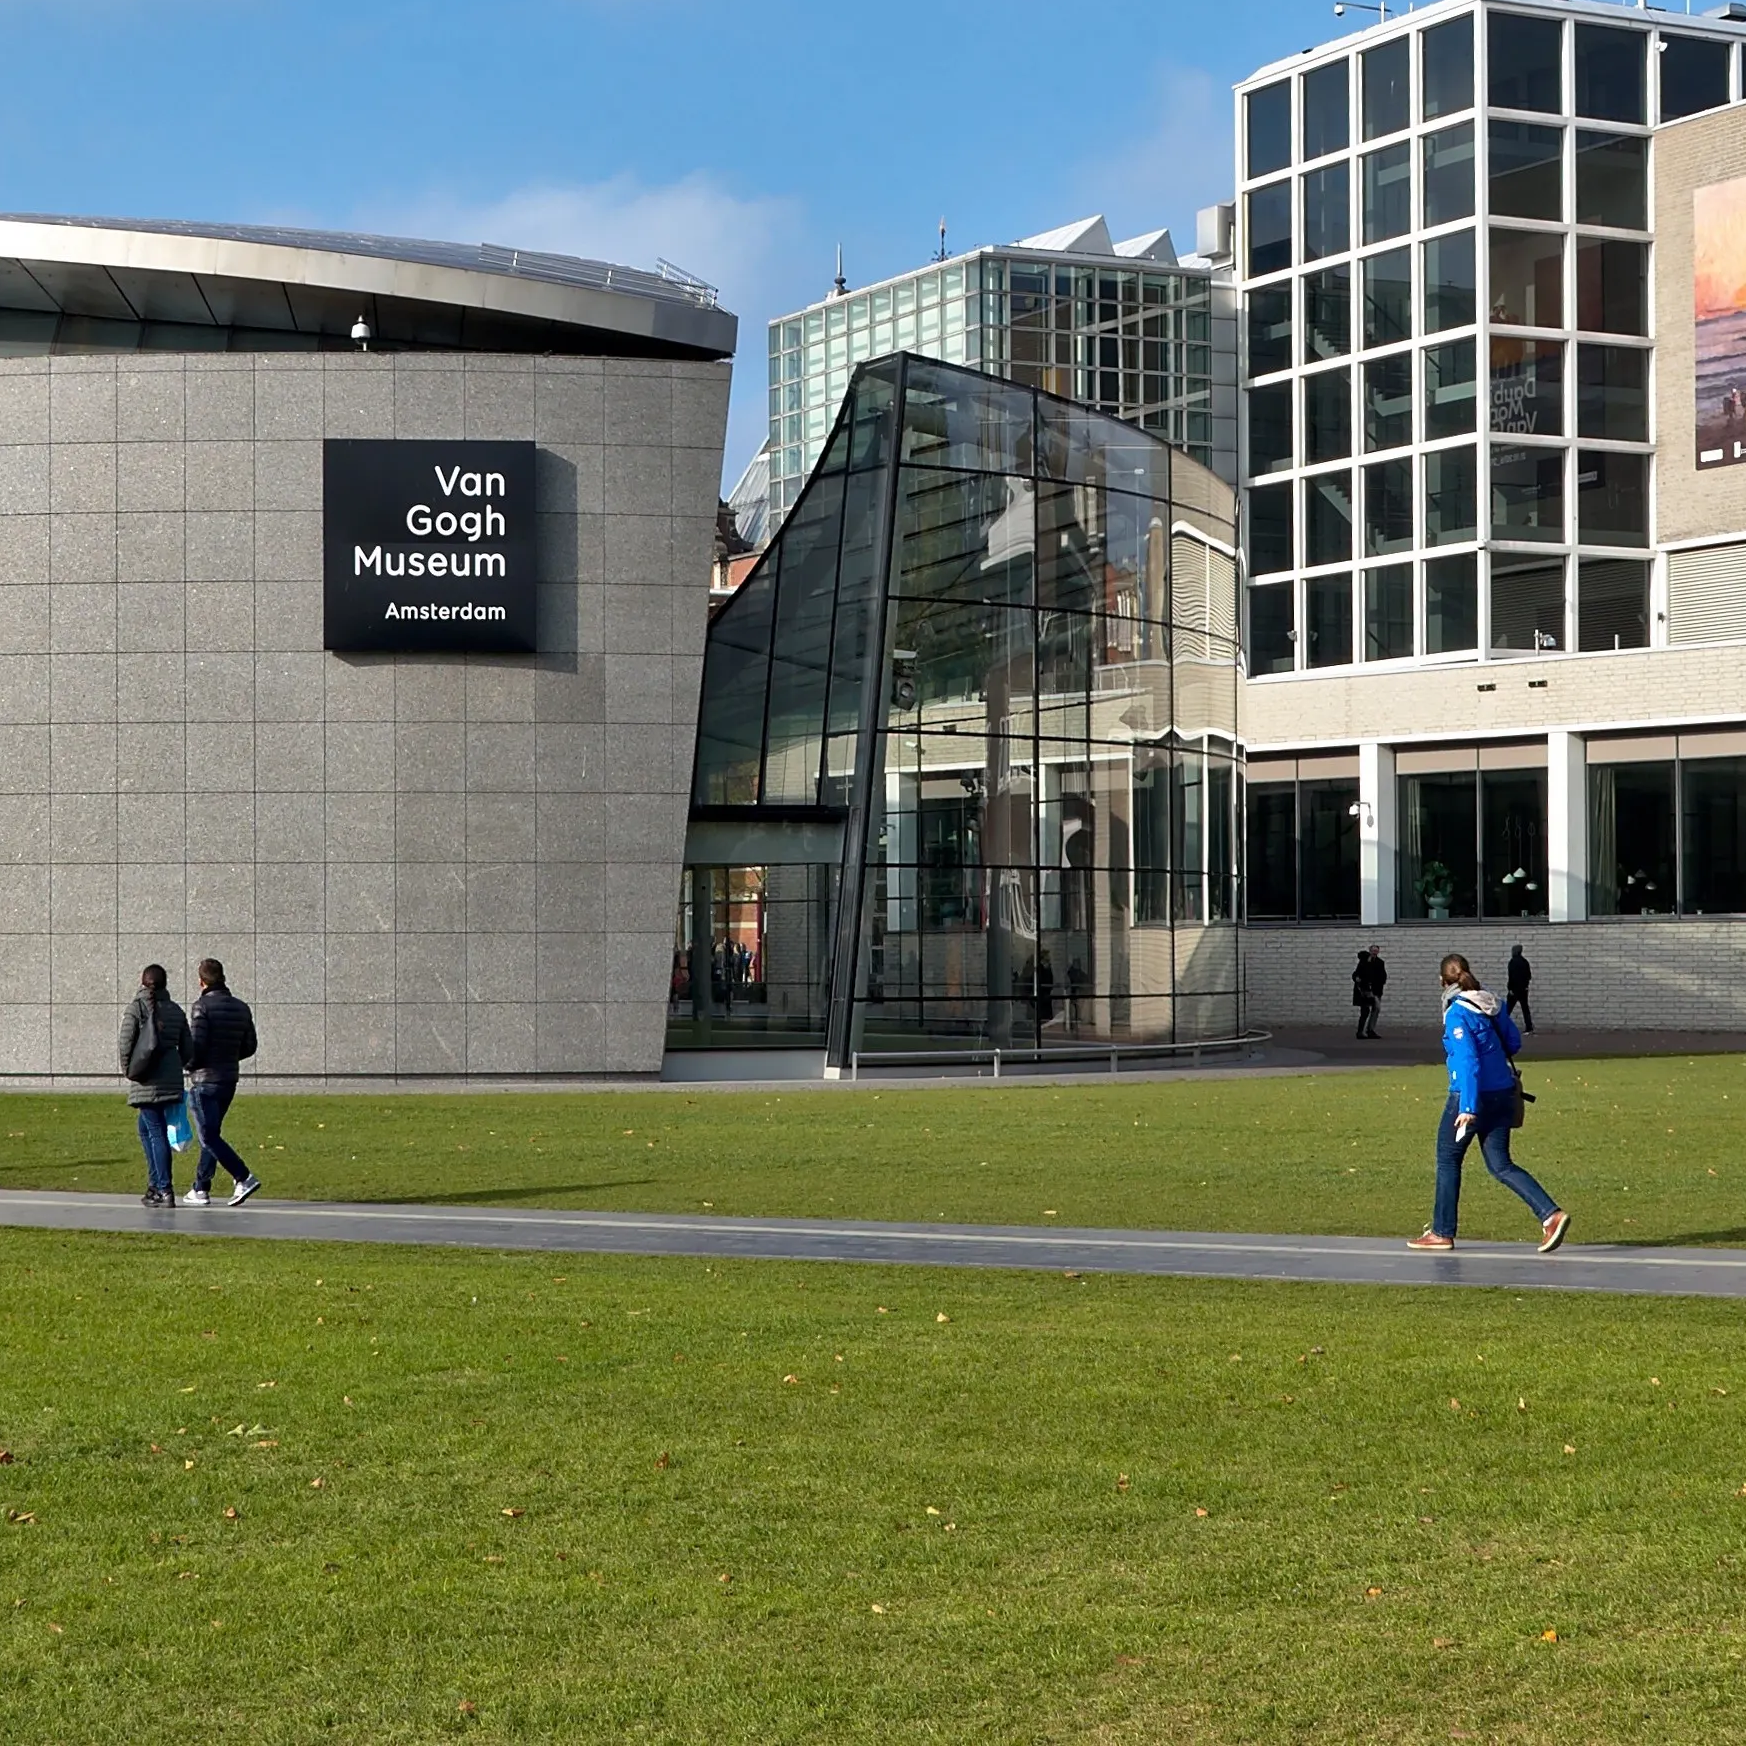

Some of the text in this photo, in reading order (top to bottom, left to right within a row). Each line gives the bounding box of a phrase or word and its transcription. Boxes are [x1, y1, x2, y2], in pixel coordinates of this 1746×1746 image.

[435, 465, 506, 497] Van
[406, 504, 506, 542] Gogh
[354, 546, 506, 577] Museum
[385, 602, 506, 620] Amsterdam
